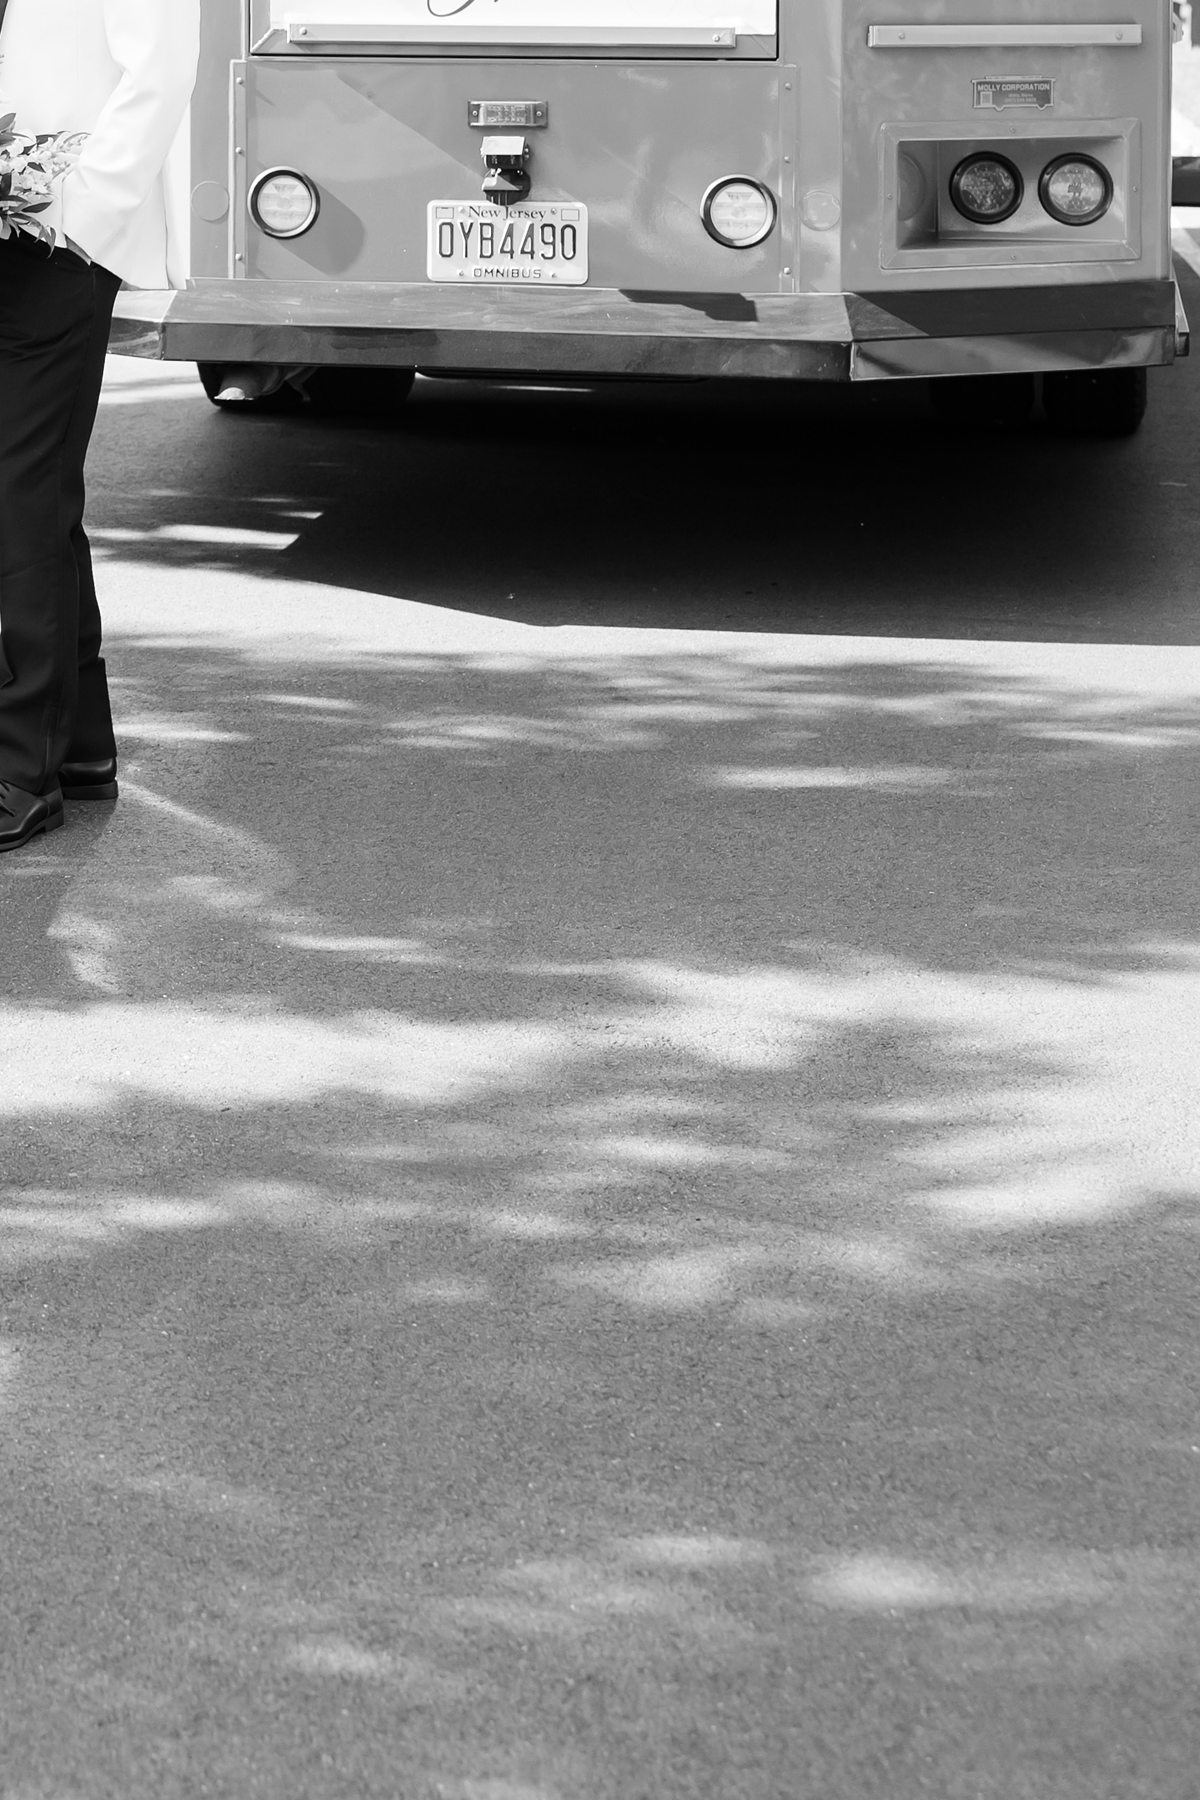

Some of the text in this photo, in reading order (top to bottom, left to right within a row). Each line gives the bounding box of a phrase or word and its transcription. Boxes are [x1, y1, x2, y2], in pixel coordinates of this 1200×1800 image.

[977, 83, 1050, 92] MOLLY CORPORATION
[468, 205, 546, 221] New Jersey
[473, 268, 542, 279] OMNIBUS
